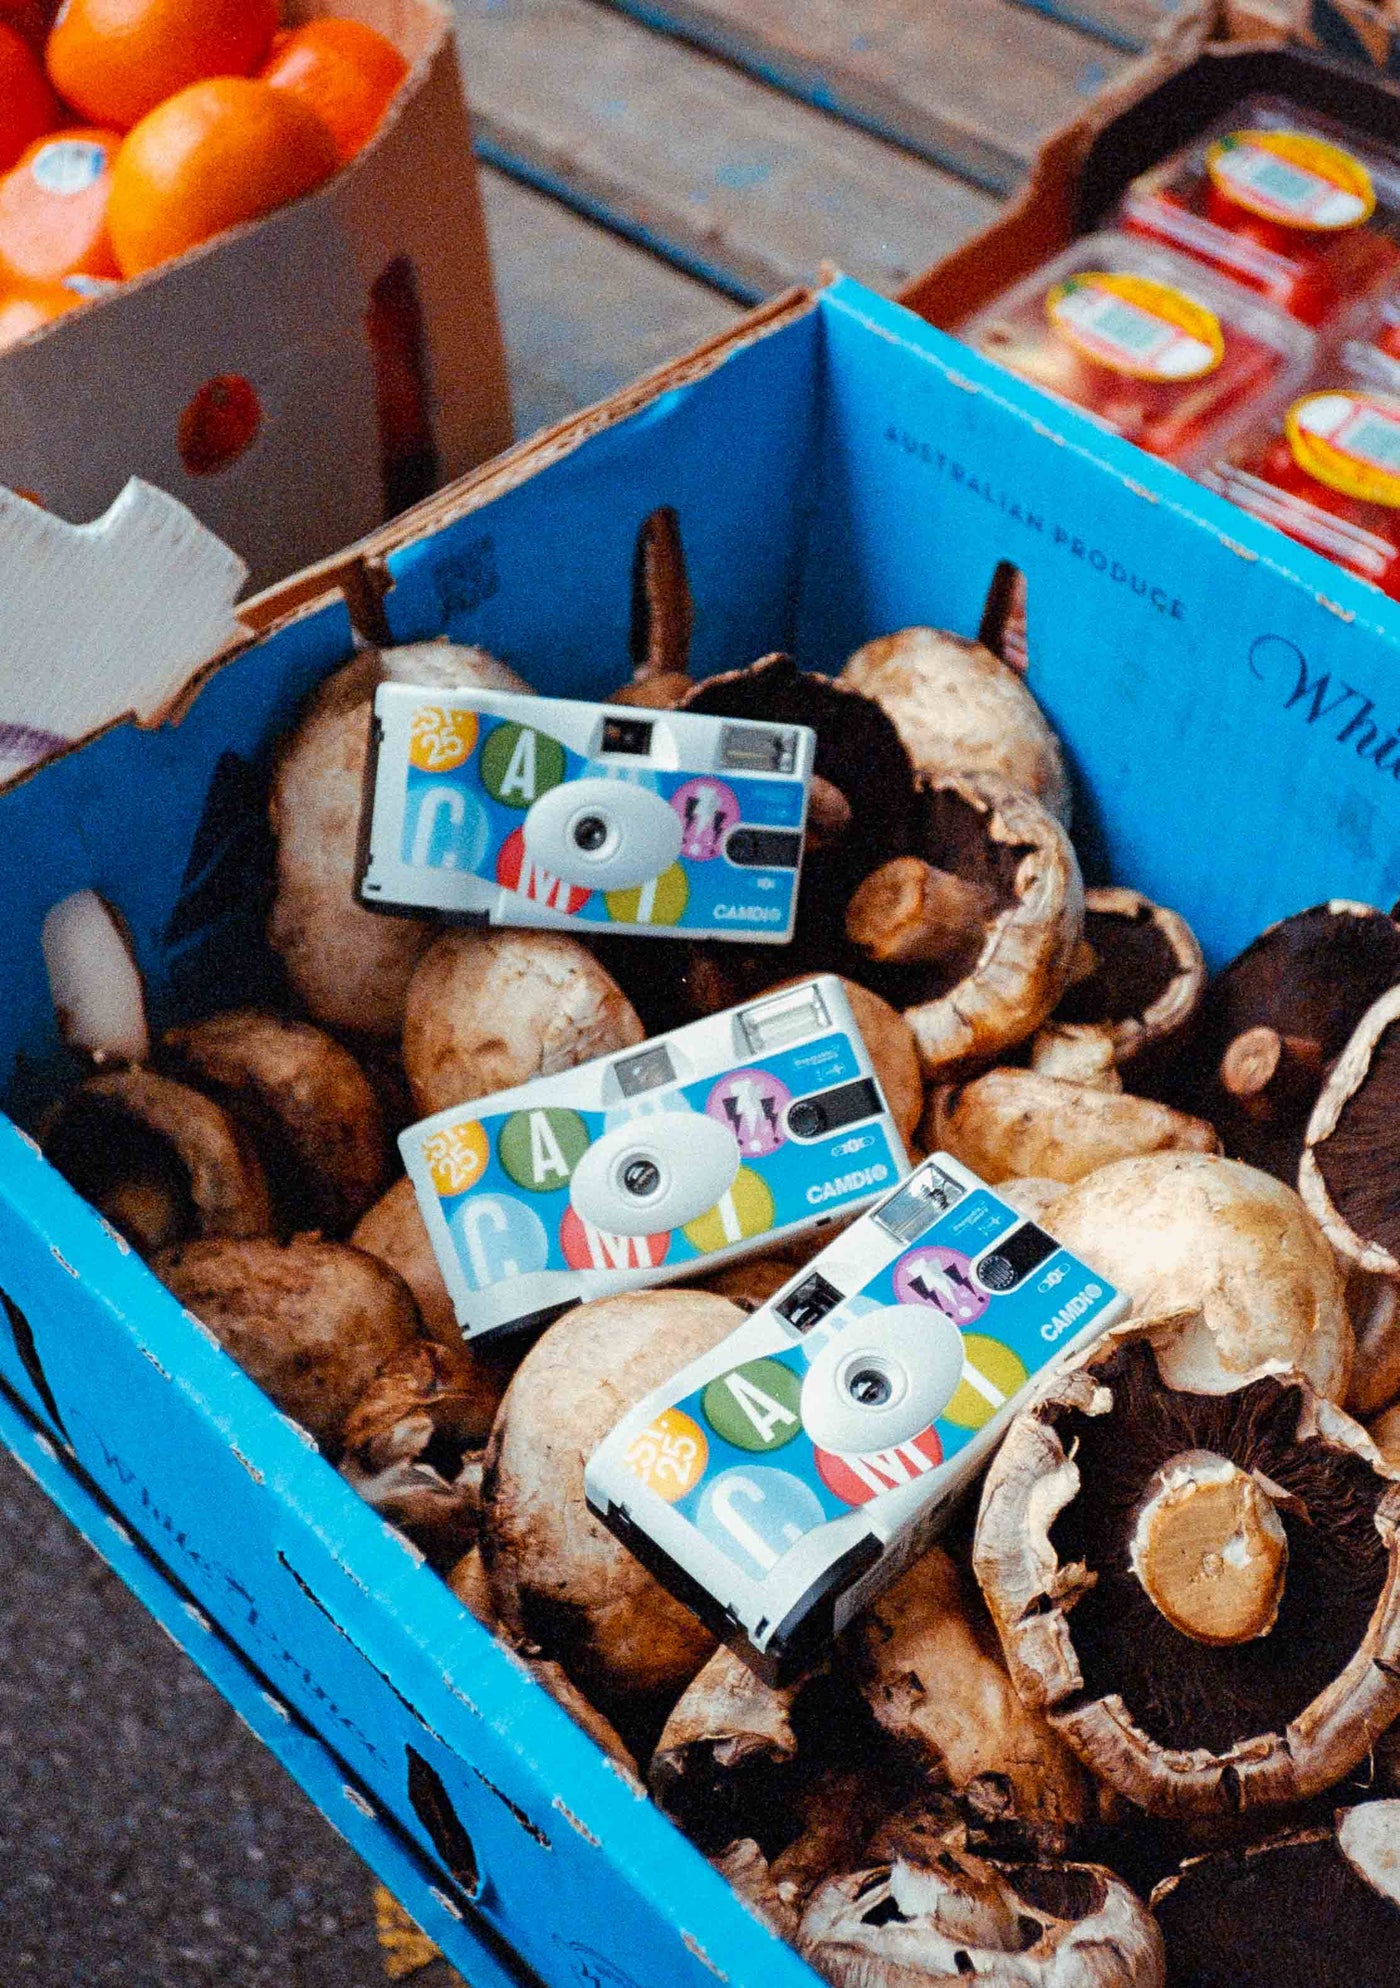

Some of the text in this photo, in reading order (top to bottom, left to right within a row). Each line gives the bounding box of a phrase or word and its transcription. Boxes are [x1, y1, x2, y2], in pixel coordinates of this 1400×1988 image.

[884, 425, 1187, 622] AUSTRALIAN PRODUCE
[1248, 633, 1400, 784] Whi
[499, 729, 537, 801] A
[527, 1110, 570, 1184] A
[721, 1370, 798, 1444] A
